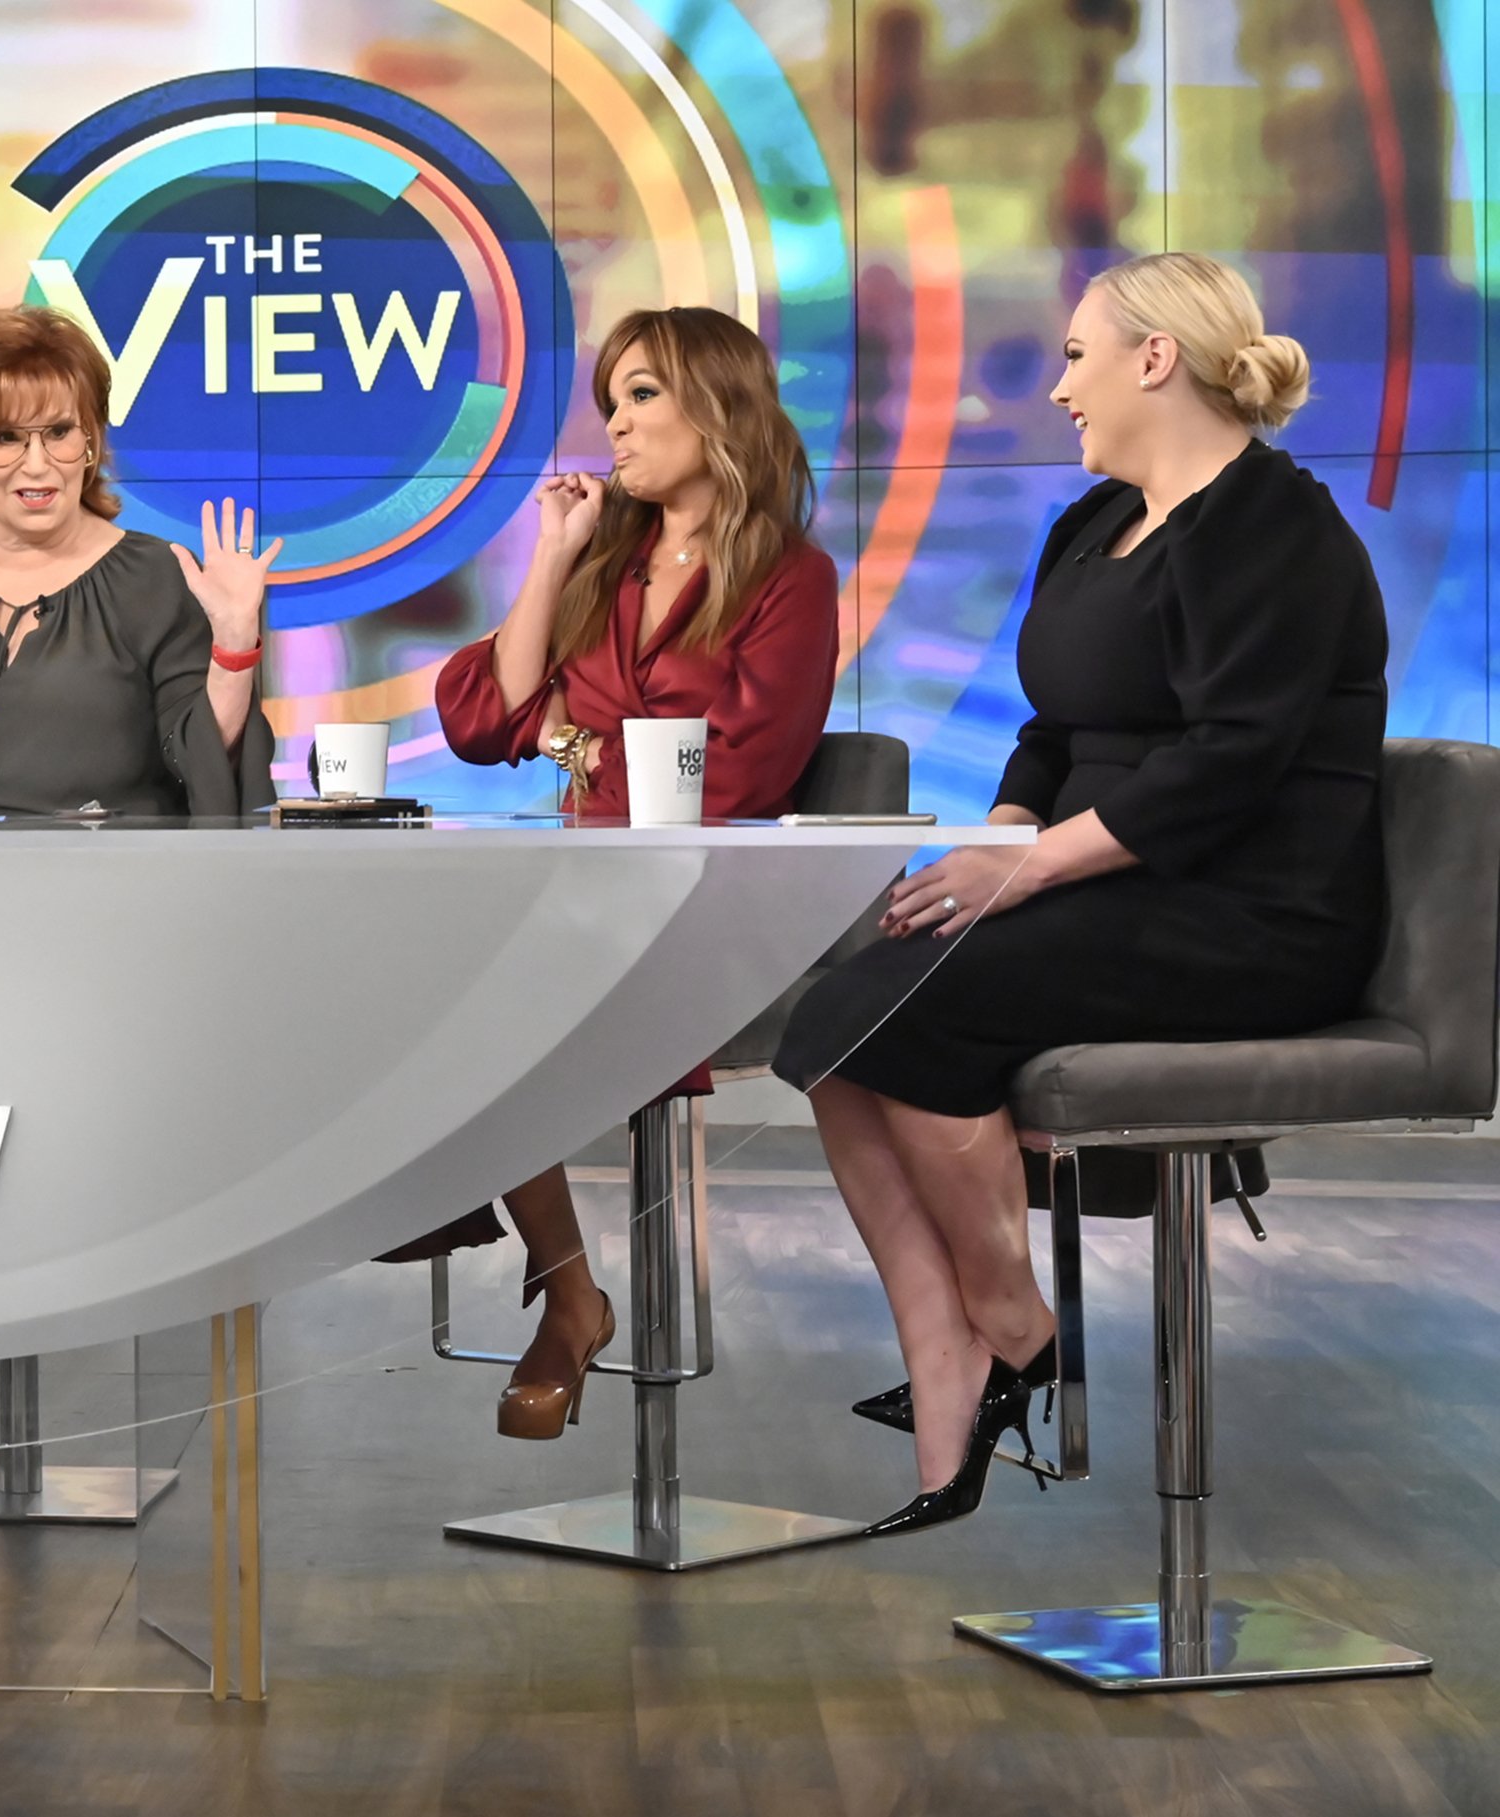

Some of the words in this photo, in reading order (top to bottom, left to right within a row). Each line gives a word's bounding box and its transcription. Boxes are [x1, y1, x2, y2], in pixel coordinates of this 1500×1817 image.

[205, 234, 323, 274] THE
[27, 256, 462, 427] VIEW
[678, 762, 703, 776] TOP
